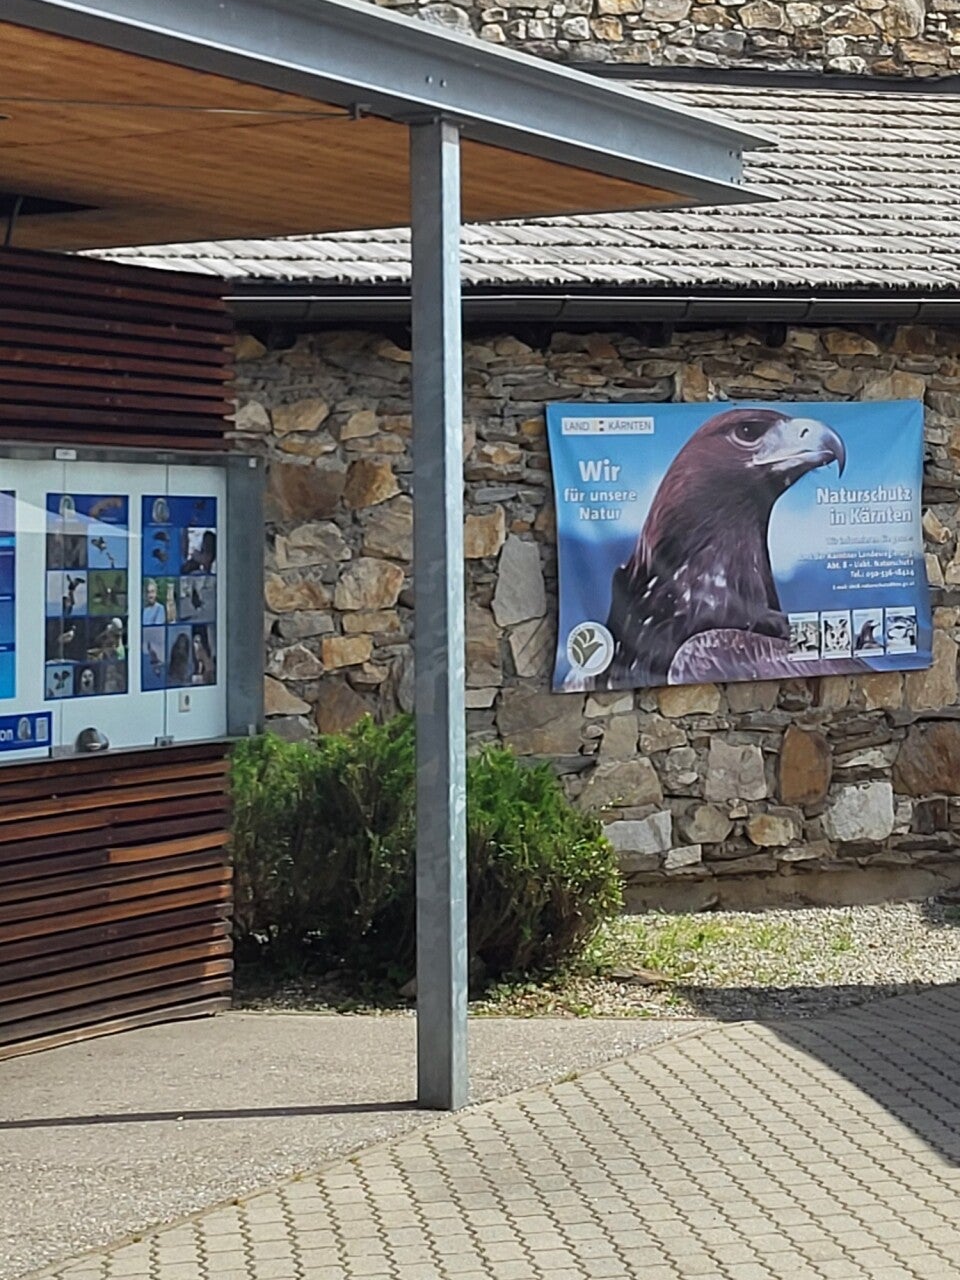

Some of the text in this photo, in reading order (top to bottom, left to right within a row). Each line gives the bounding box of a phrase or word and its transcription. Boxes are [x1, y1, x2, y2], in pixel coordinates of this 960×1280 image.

[564, 420, 651, 431] LAND KÄRNTEN
[578, 458, 620, 482] Wir
[564, 487, 637, 502] für unsere
[815, 485, 912, 504] Naturschutz
[579, 506, 621, 520] Natur
[830, 506, 912, 525] in Kärnten
